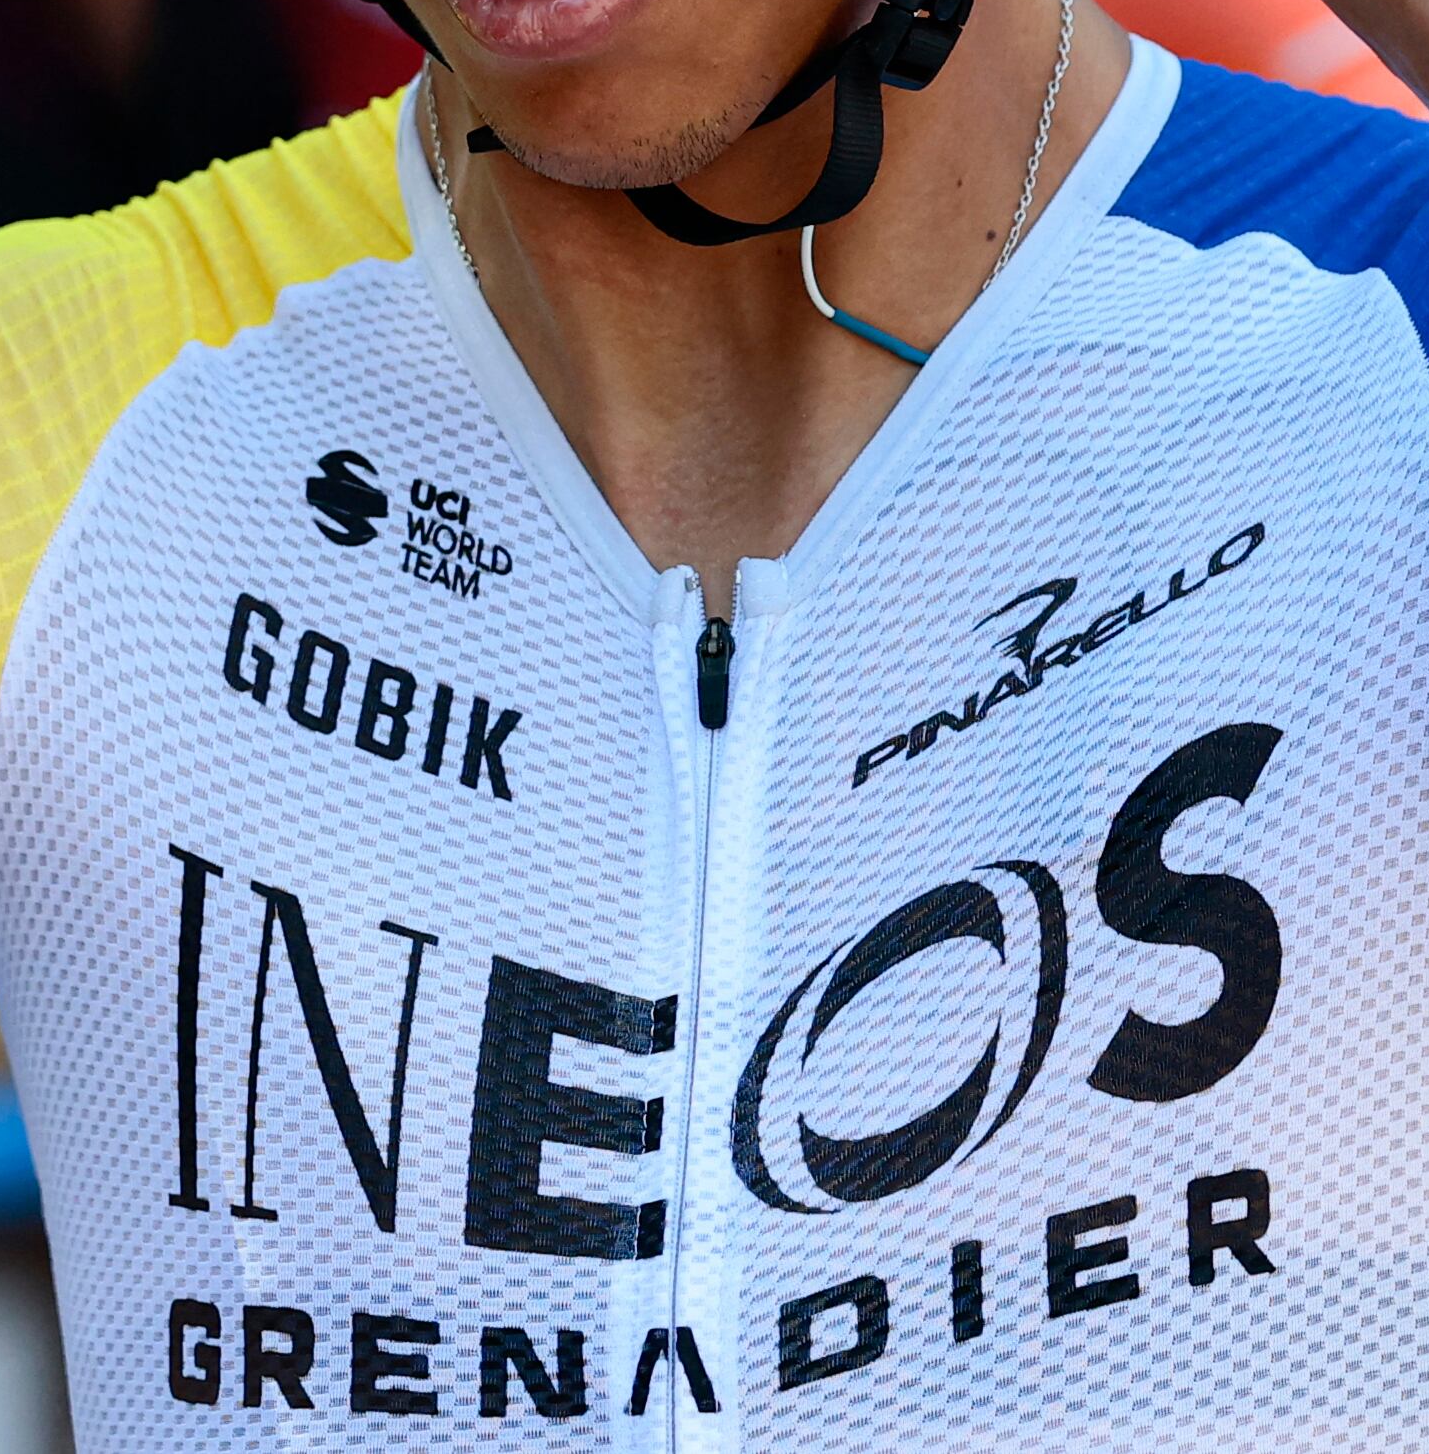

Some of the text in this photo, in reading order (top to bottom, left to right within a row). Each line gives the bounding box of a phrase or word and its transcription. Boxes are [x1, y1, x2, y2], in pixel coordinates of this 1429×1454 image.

[401, 542, 482, 600] TEAM
[406, 510, 513, 576] WORLD
[410, 478, 471, 526] UCI
[223, 592, 524, 804] GOBIK
[851, 521, 1266, 789] PINARELLO
[168, 721, 1284, 1262] INEOS
[167, 1168, 1278, 1426] GRENADIER
